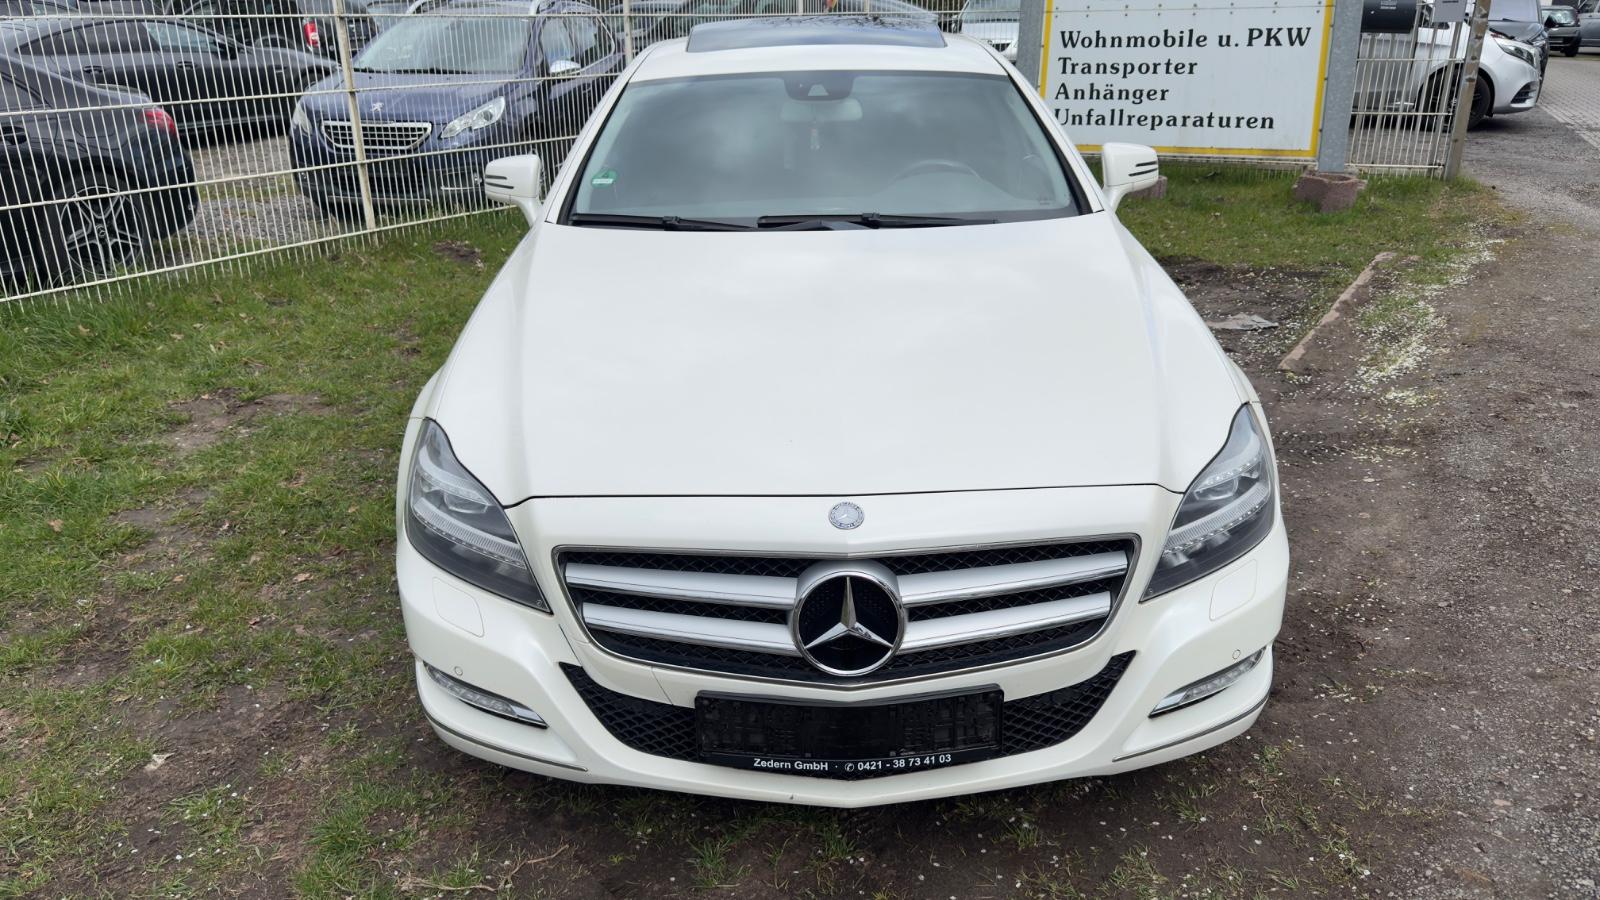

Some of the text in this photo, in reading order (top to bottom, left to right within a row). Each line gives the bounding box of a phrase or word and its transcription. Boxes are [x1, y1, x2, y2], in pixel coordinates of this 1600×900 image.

[1060, 27, 1312, 49] Wohnmobile u. PKW
[1057, 56, 1198, 79] Transporter
[1054, 82, 1170, 105] Anhänger
[1054, 108, 1274, 131] Unfallreparaturen
[753, 758, 791, 769] Zedern
[794, 761, 829, 771] GmbH
[857, 761, 882, 771] 0421
[892, 759, 906, 769] 38
[908, 757, 921, 767] 73
[923, 756, 935, 765] 41
[939, 754, 952, 764] 03
